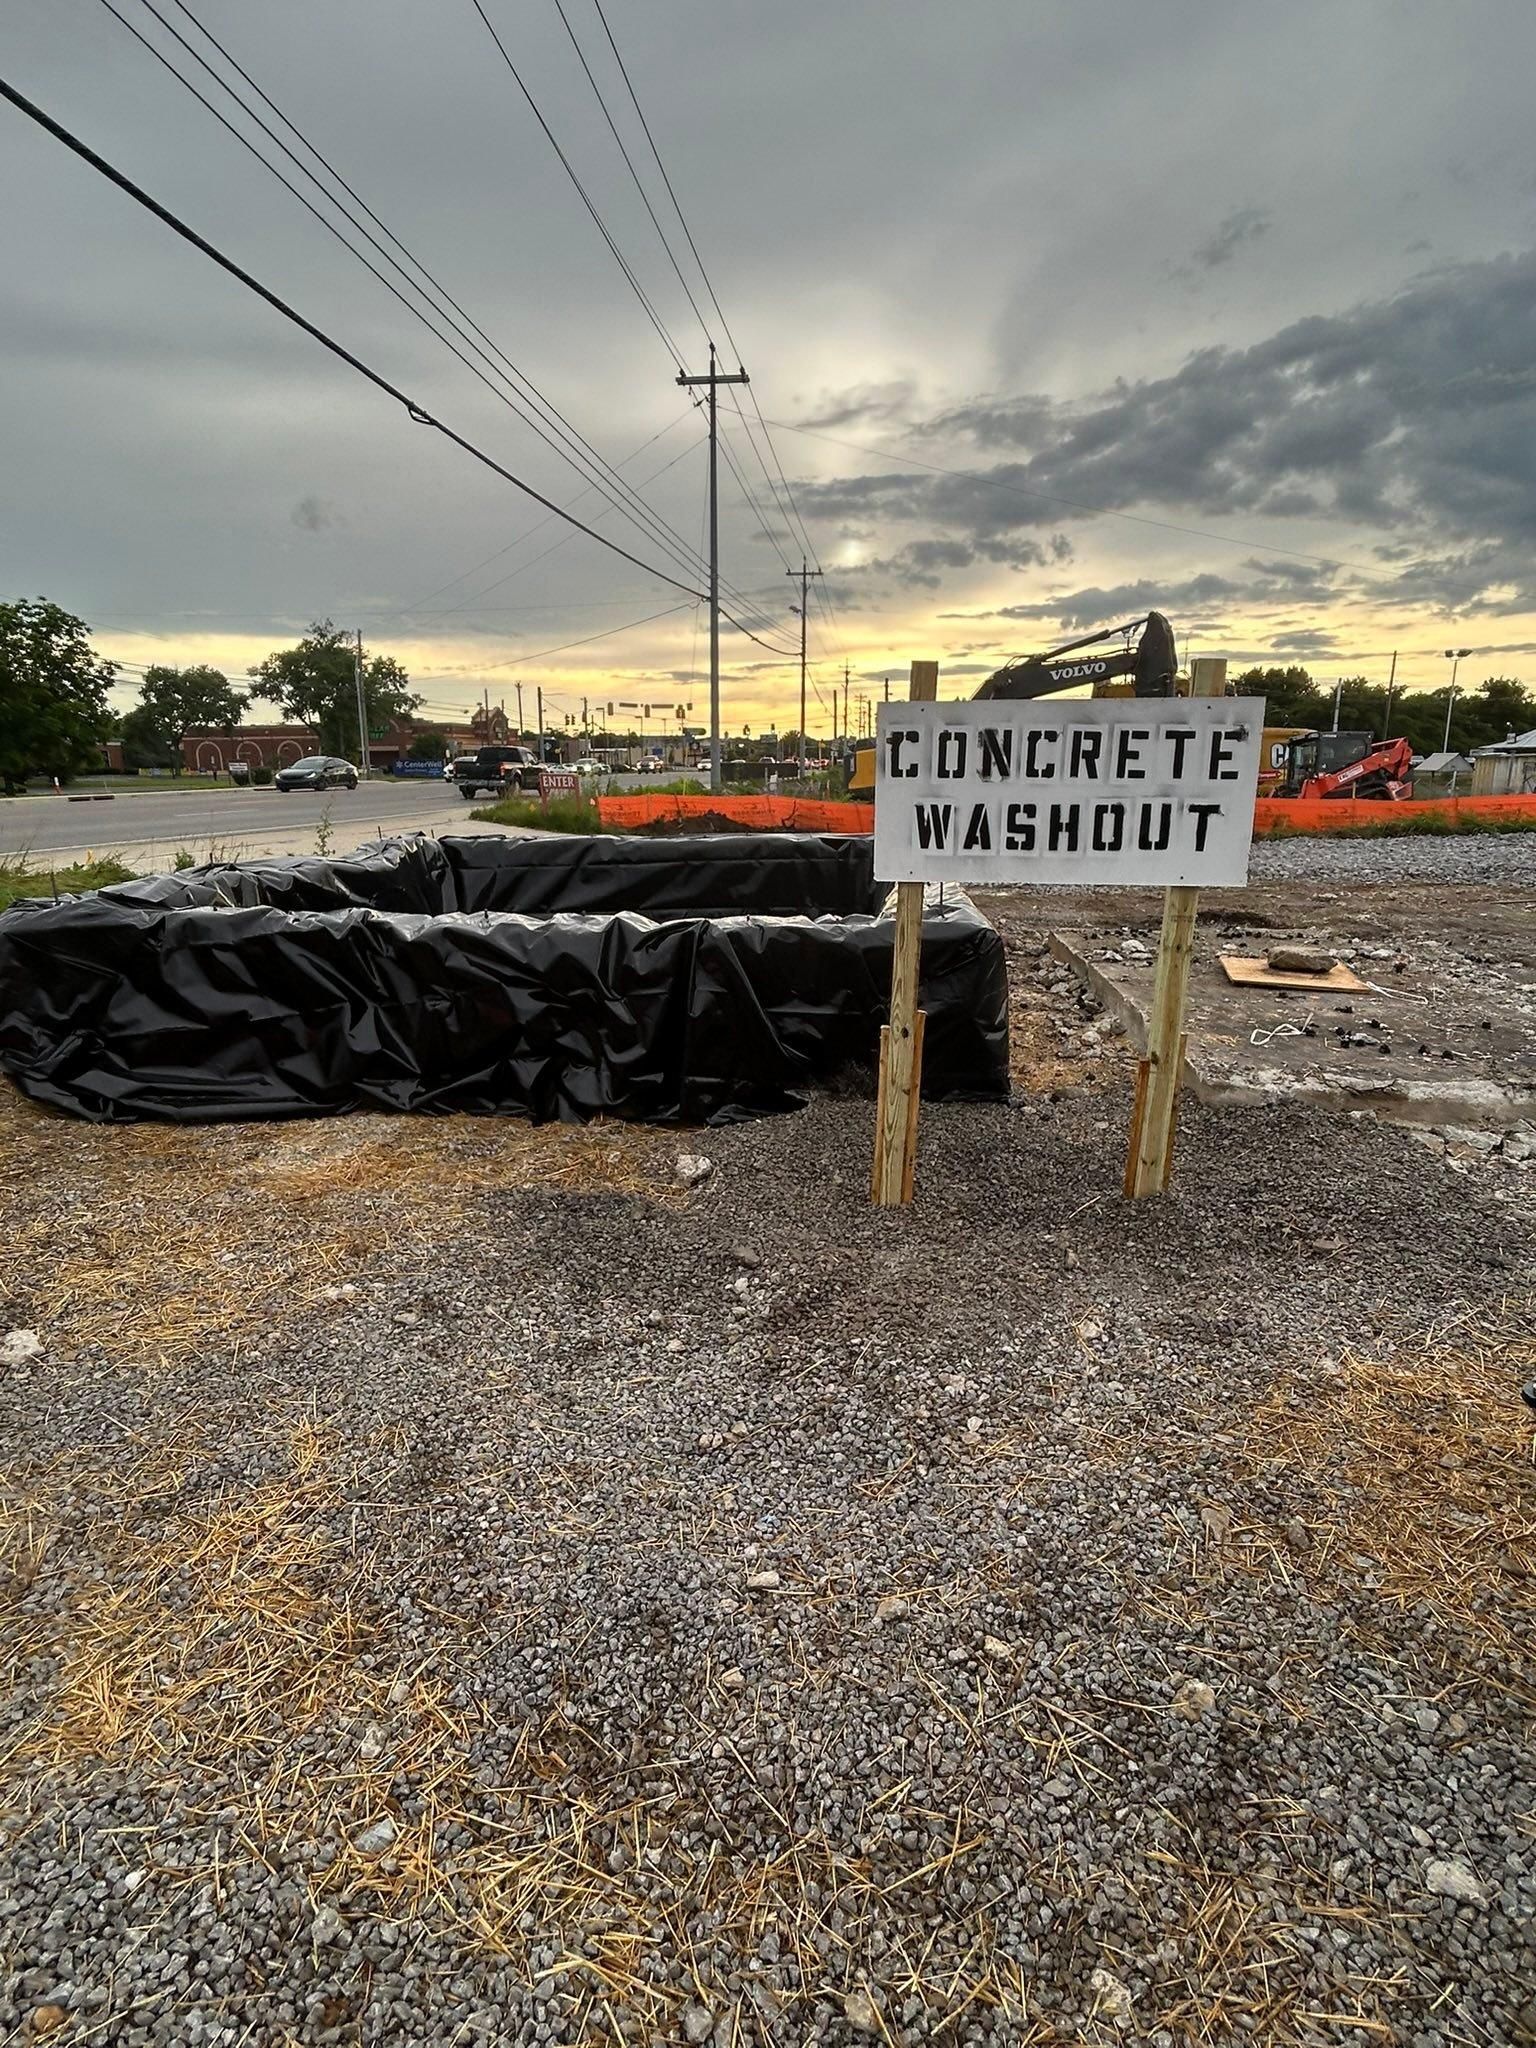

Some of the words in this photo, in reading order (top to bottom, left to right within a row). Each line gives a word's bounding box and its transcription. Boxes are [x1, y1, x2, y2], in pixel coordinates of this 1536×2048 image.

[1049, 662, 1106, 680] VOLVO
[886, 727, 1248, 780] CONCRETE
[543, 775, 575, 788] ENTER
[915, 803, 1224, 852] WASHOUT
